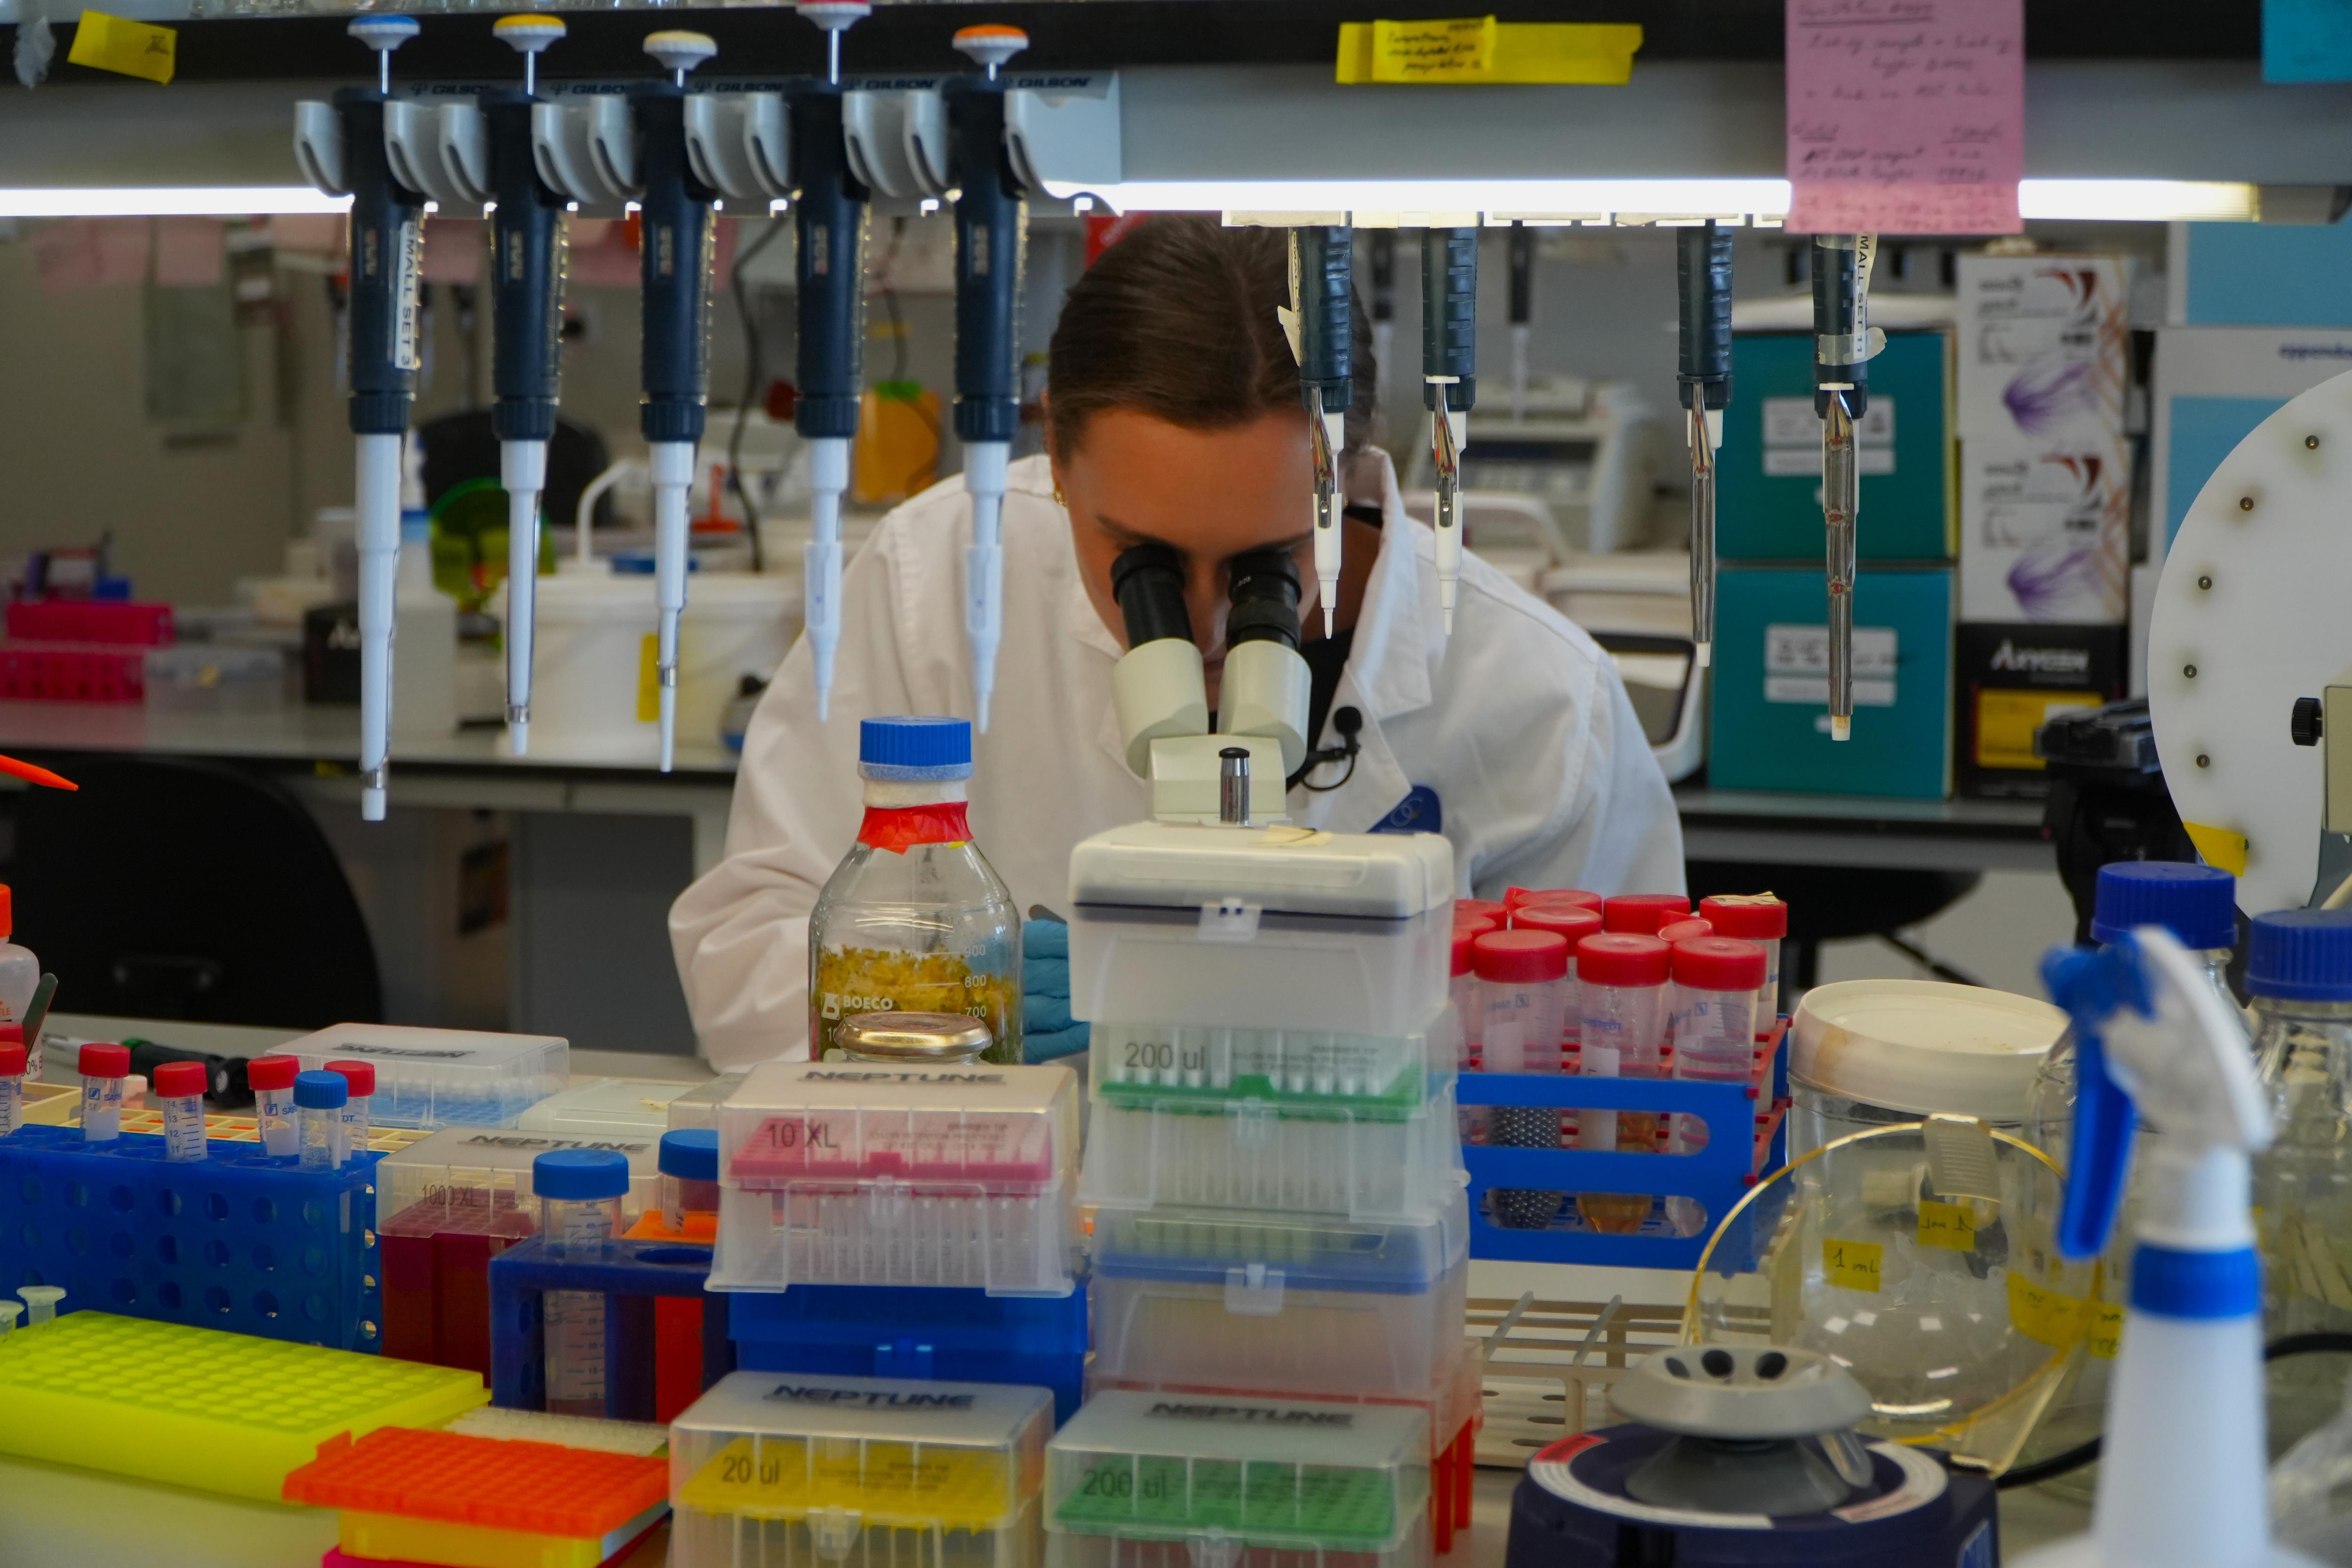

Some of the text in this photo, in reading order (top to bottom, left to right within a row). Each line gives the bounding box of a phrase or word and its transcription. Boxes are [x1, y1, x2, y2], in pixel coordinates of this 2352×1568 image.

[431, 84, 484, 95] GILSO
[572, 84, 625, 95] GILSO
[866, 78, 937, 90] GILSON
[1017, 77, 1091, 88] GILSON
[403, 223, 414, 299] SMALL
[1858, 236, 1869, 286] MALL
[402, 306, 412, 348] SET
[964, 945, 985, 957] 900
[964, 975, 986, 988] 800
[842, 995, 893, 1011] BOECO
[965, 1006, 986, 1018] 700
[1125, 1043, 1174, 1069] 200
[1183, 1046, 1205, 1071] ul
[806, 1071, 1004, 1082] NEPTUNE
[468, 1135, 651, 1152] NEPTUNE
[769, 1122, 839, 1148] 10 XL
[421, 1184, 454, 1206] 1000
[460, 1186, 477, 1207] XL
[1833, 1247, 1845, 1267] 1
[772, 1385, 975, 1407] NEPTUNE
[1151, 1402, 1354, 1425] NEPTUNE
[722, 1457, 779, 1485] 20 ul
[1082, 1471, 1133, 1499] 200
